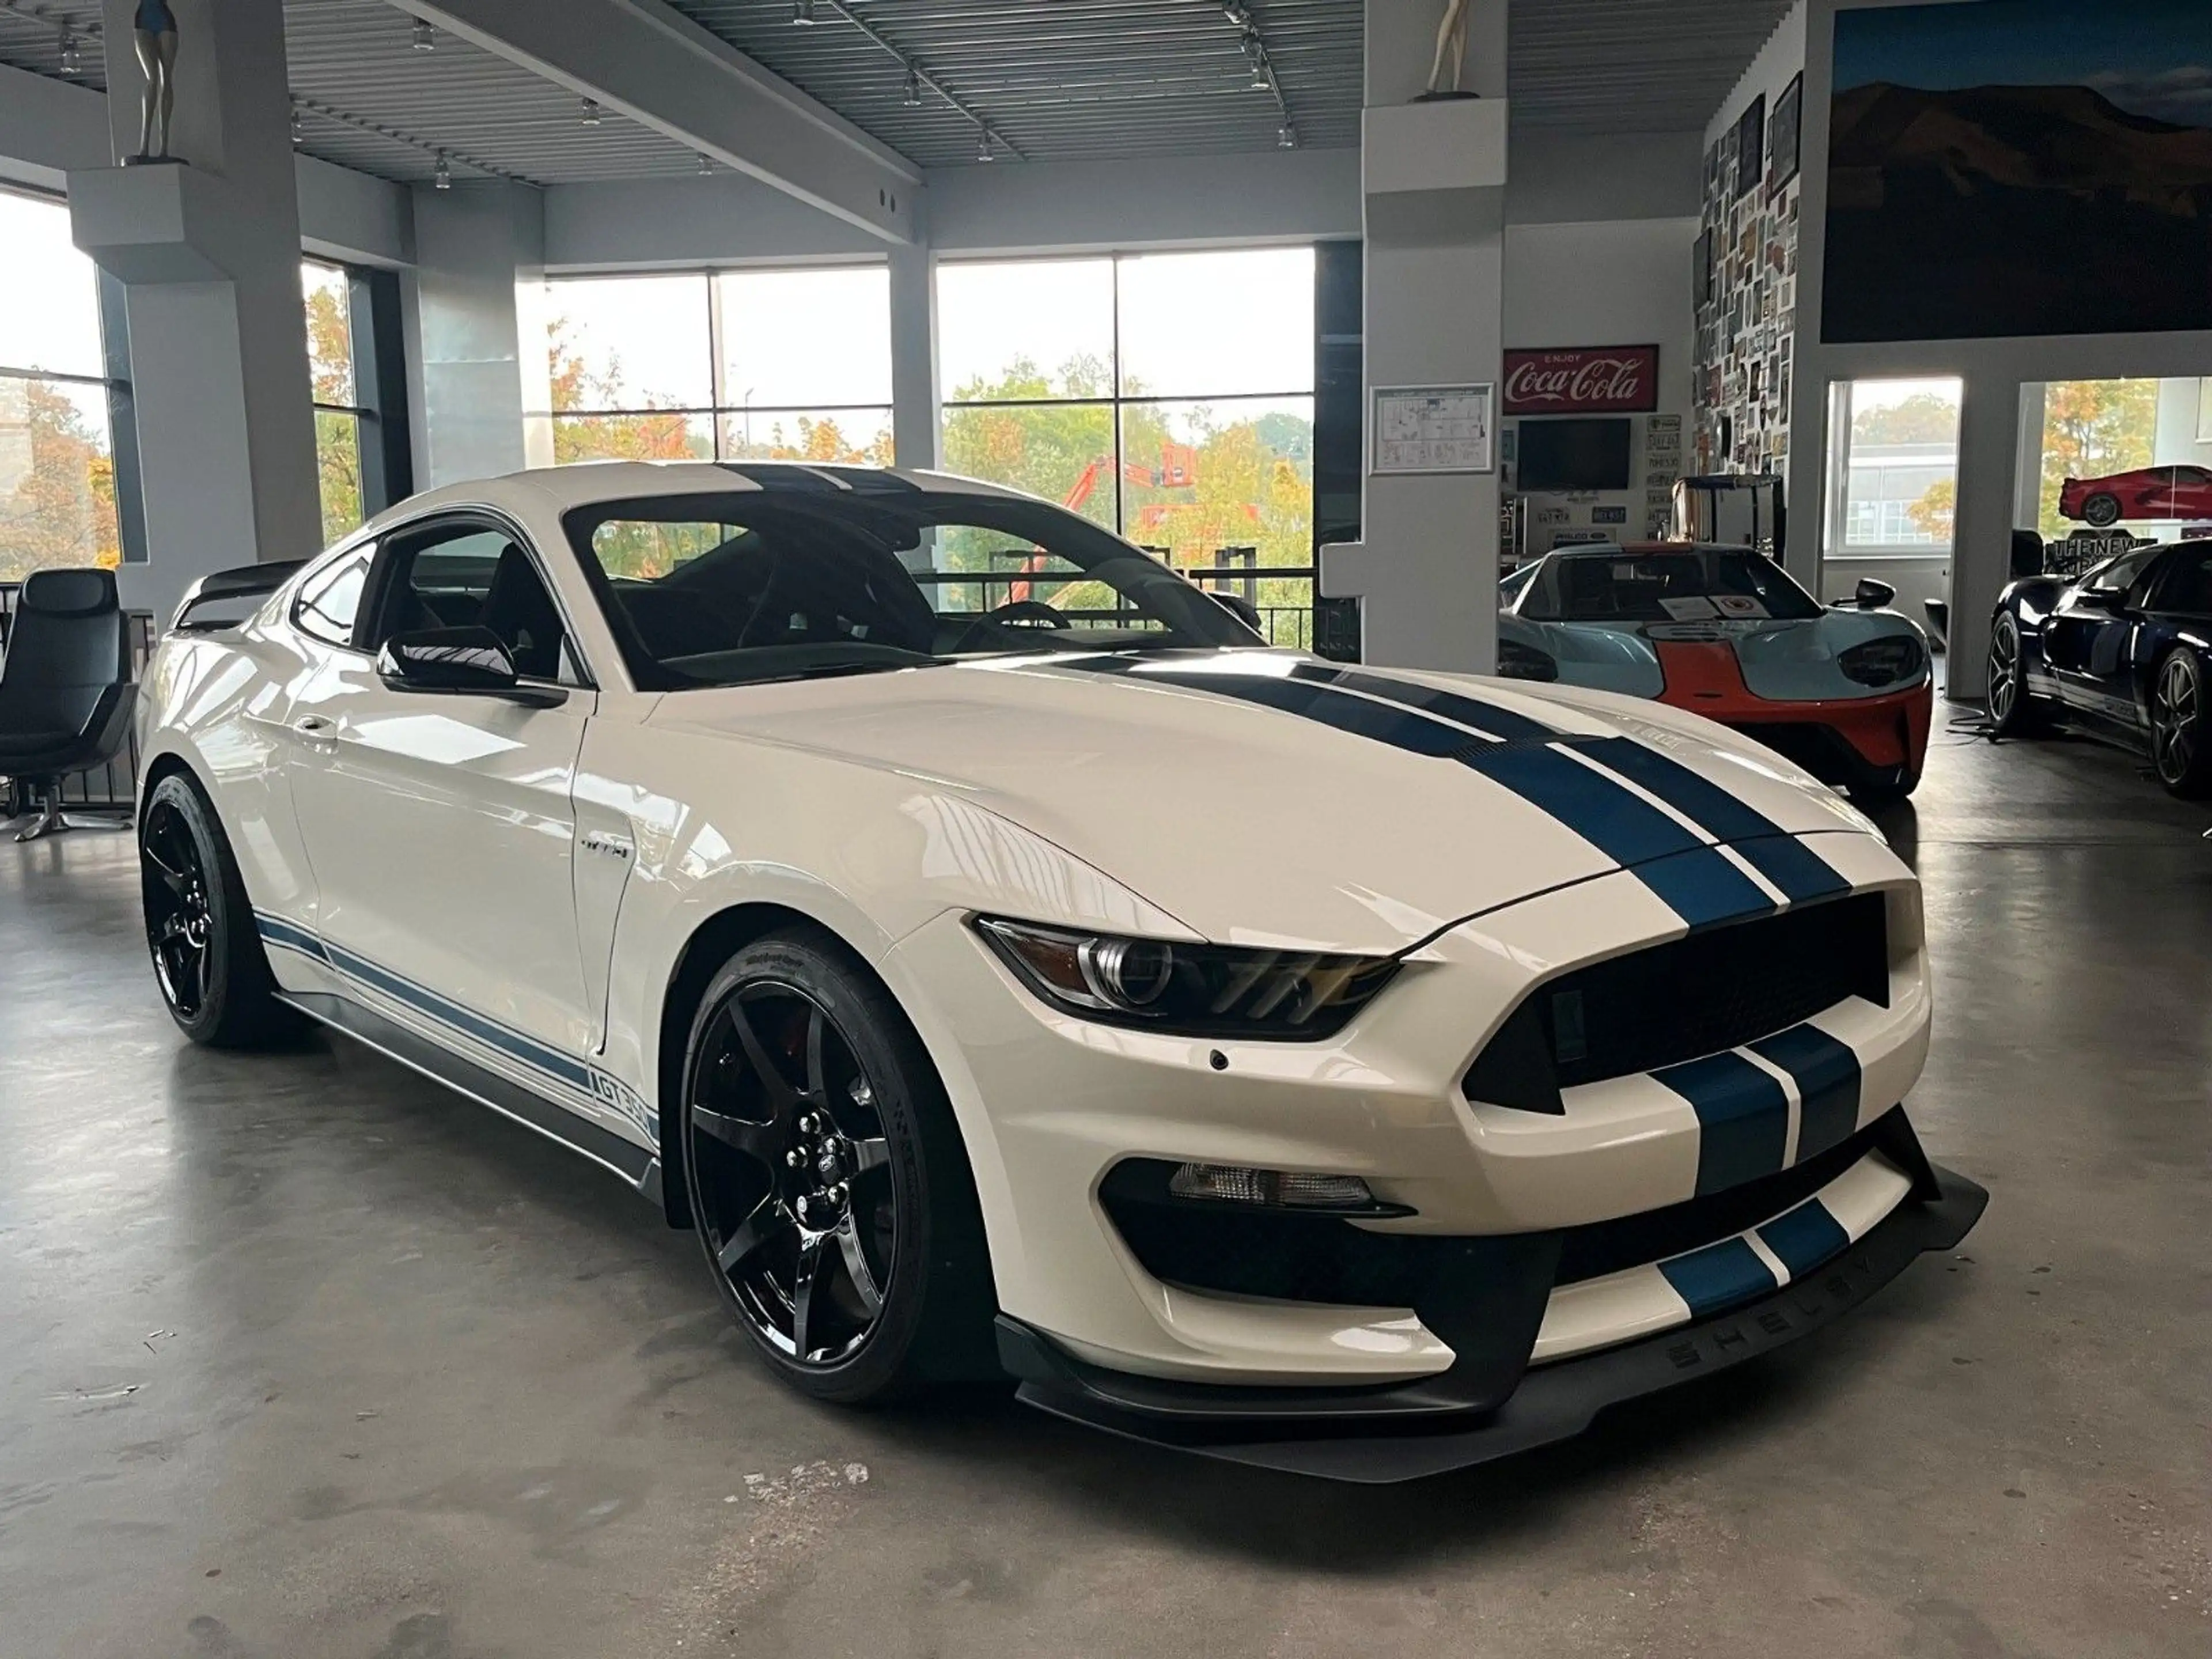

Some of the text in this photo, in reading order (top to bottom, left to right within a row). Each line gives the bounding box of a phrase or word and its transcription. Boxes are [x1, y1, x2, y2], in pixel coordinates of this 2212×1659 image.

[1544, 354, 1581, 363] ENJOY
[2055, 539, 2092, 557] THE
[599, 1075, 621, 1105] GT
